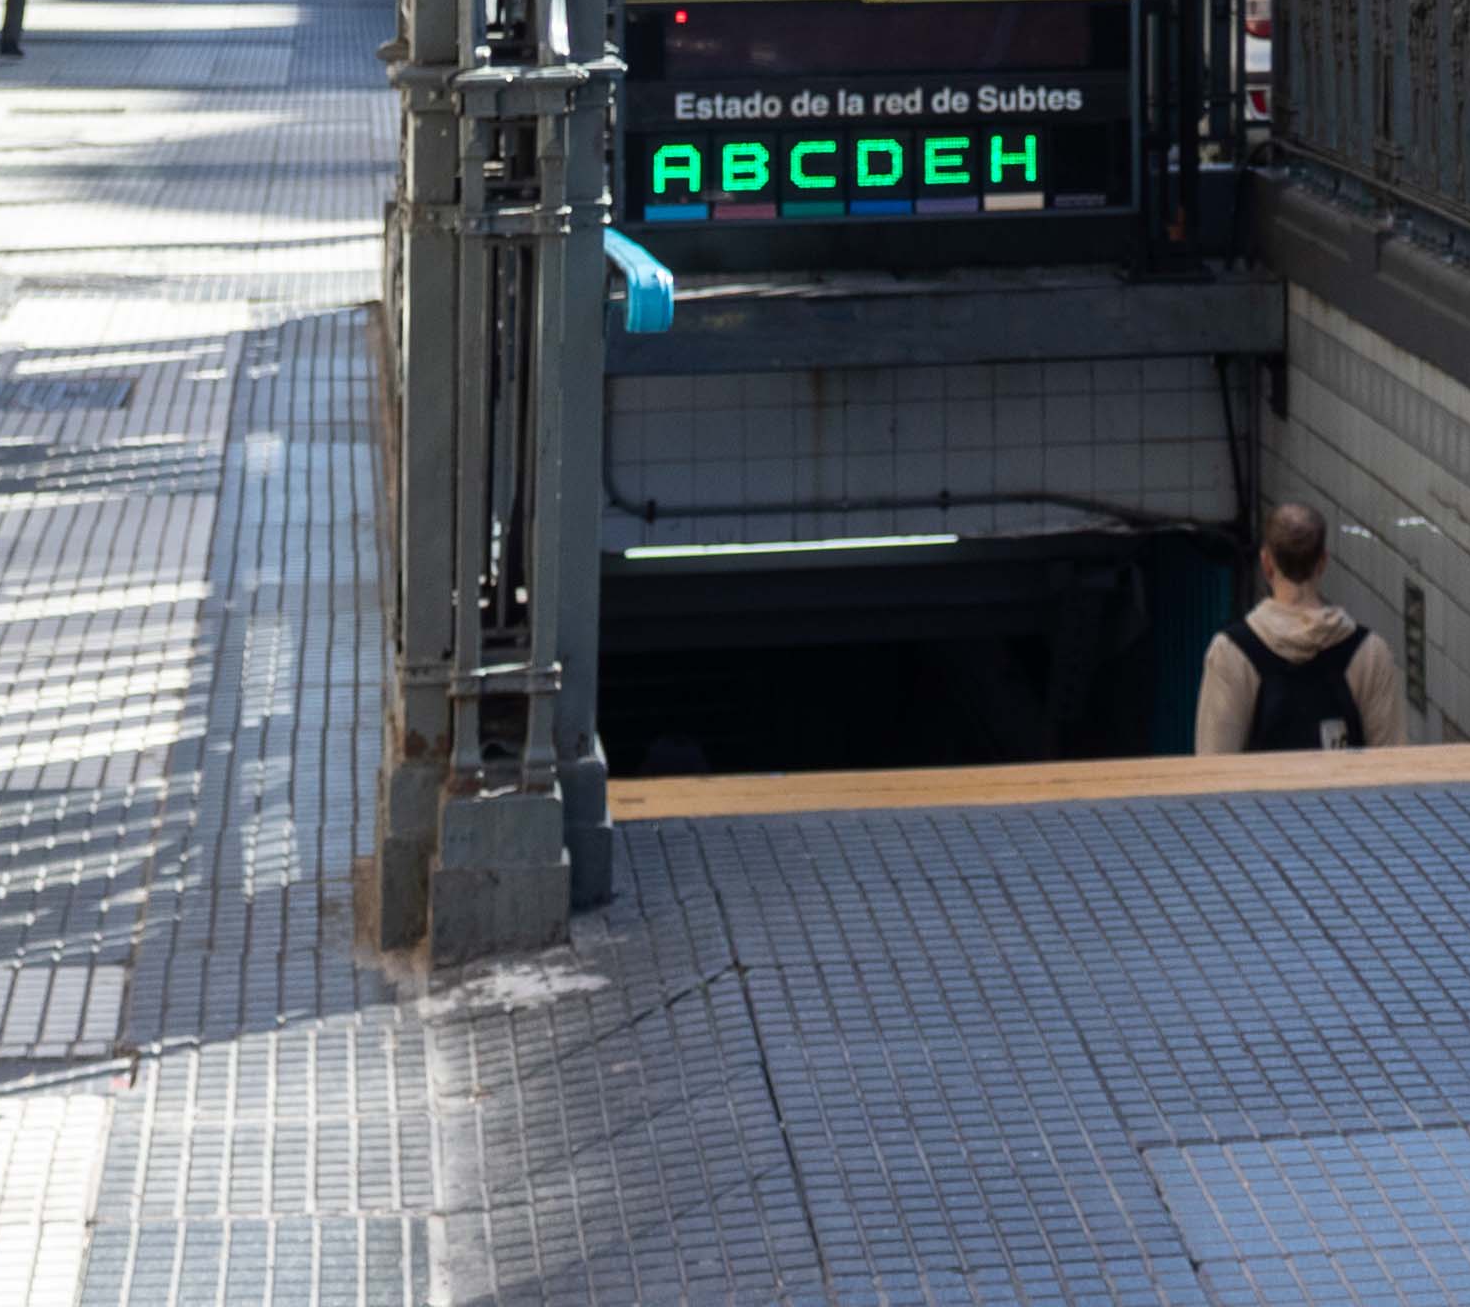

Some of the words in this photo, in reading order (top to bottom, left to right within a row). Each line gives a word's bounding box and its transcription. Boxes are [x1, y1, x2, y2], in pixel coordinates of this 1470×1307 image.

[674, 88, 781, 120] Estado
[790, 90, 830, 118] de
[838, 89, 865, 116] la
[874, 88, 922, 115] red
[931, 86, 970, 115] de
[978, 84, 1082, 112] Subtes
[652, 143, 701, 193] A
[721, 141, 770, 191] B
[790, 139, 838, 188] C
[857, 138, 904, 186] D
[924, 137, 971, 185] E
[989, 135, 1038, 183] H
